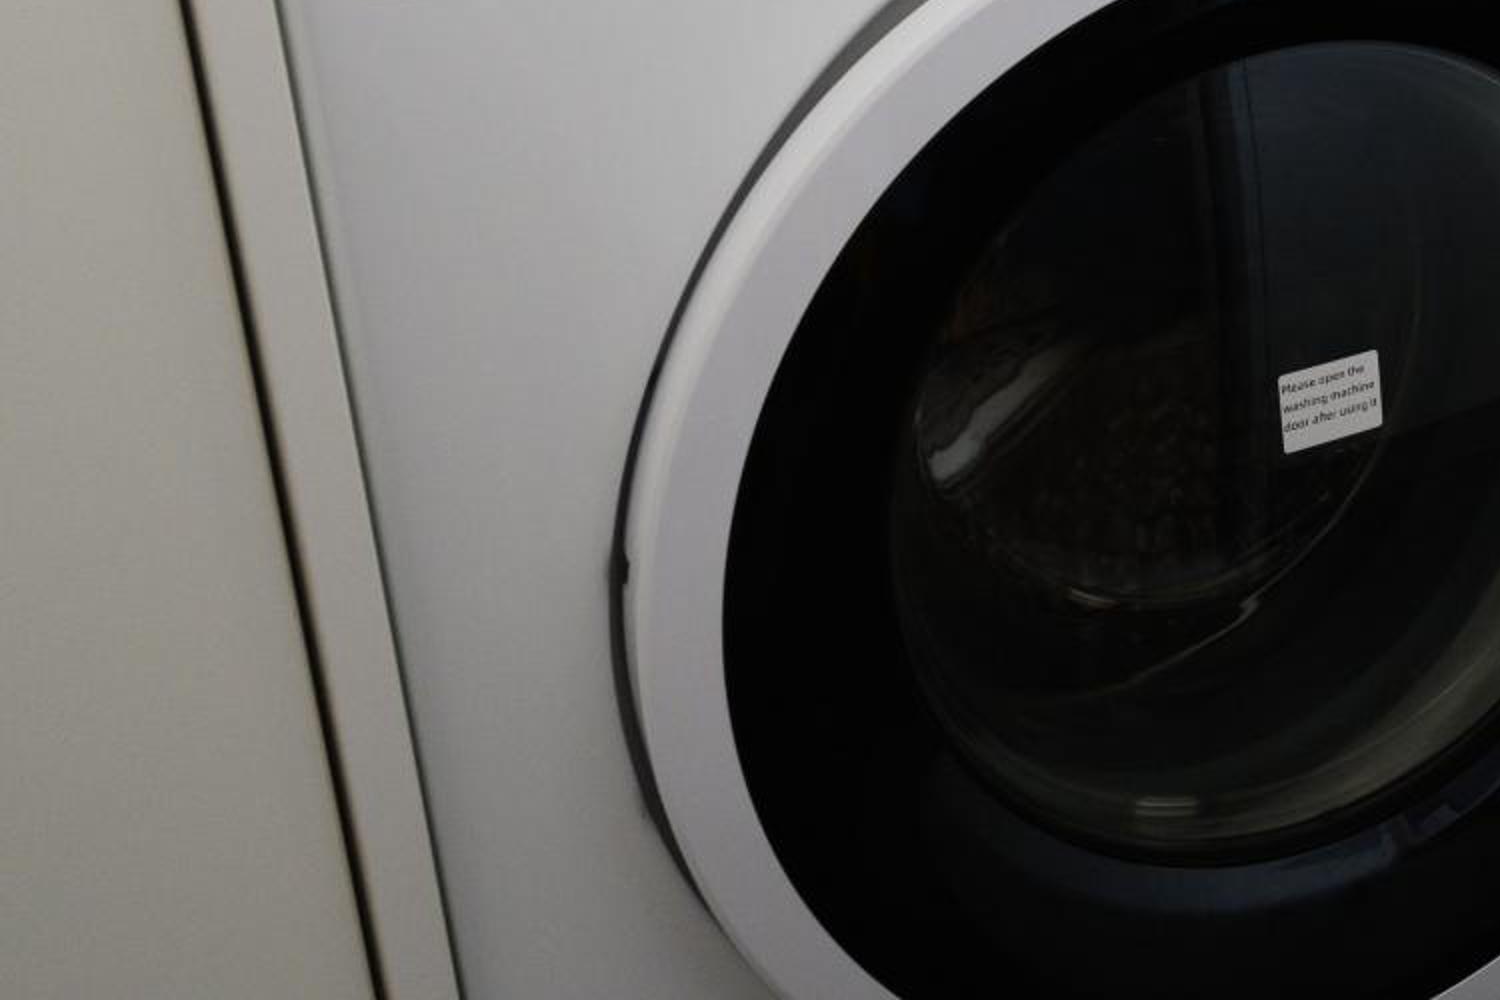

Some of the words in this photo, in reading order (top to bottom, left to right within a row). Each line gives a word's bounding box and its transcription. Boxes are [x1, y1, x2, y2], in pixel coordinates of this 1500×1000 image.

[1281, 379, 1317, 394] Please
[1347, 364, 1365, 378] the
[1283, 395, 1329, 415] washing
[1330, 381, 1375, 402] machine
[1283, 418, 1309, 433] door
[1311, 410, 1337, 425] after
[1339, 400, 1369, 418] using
